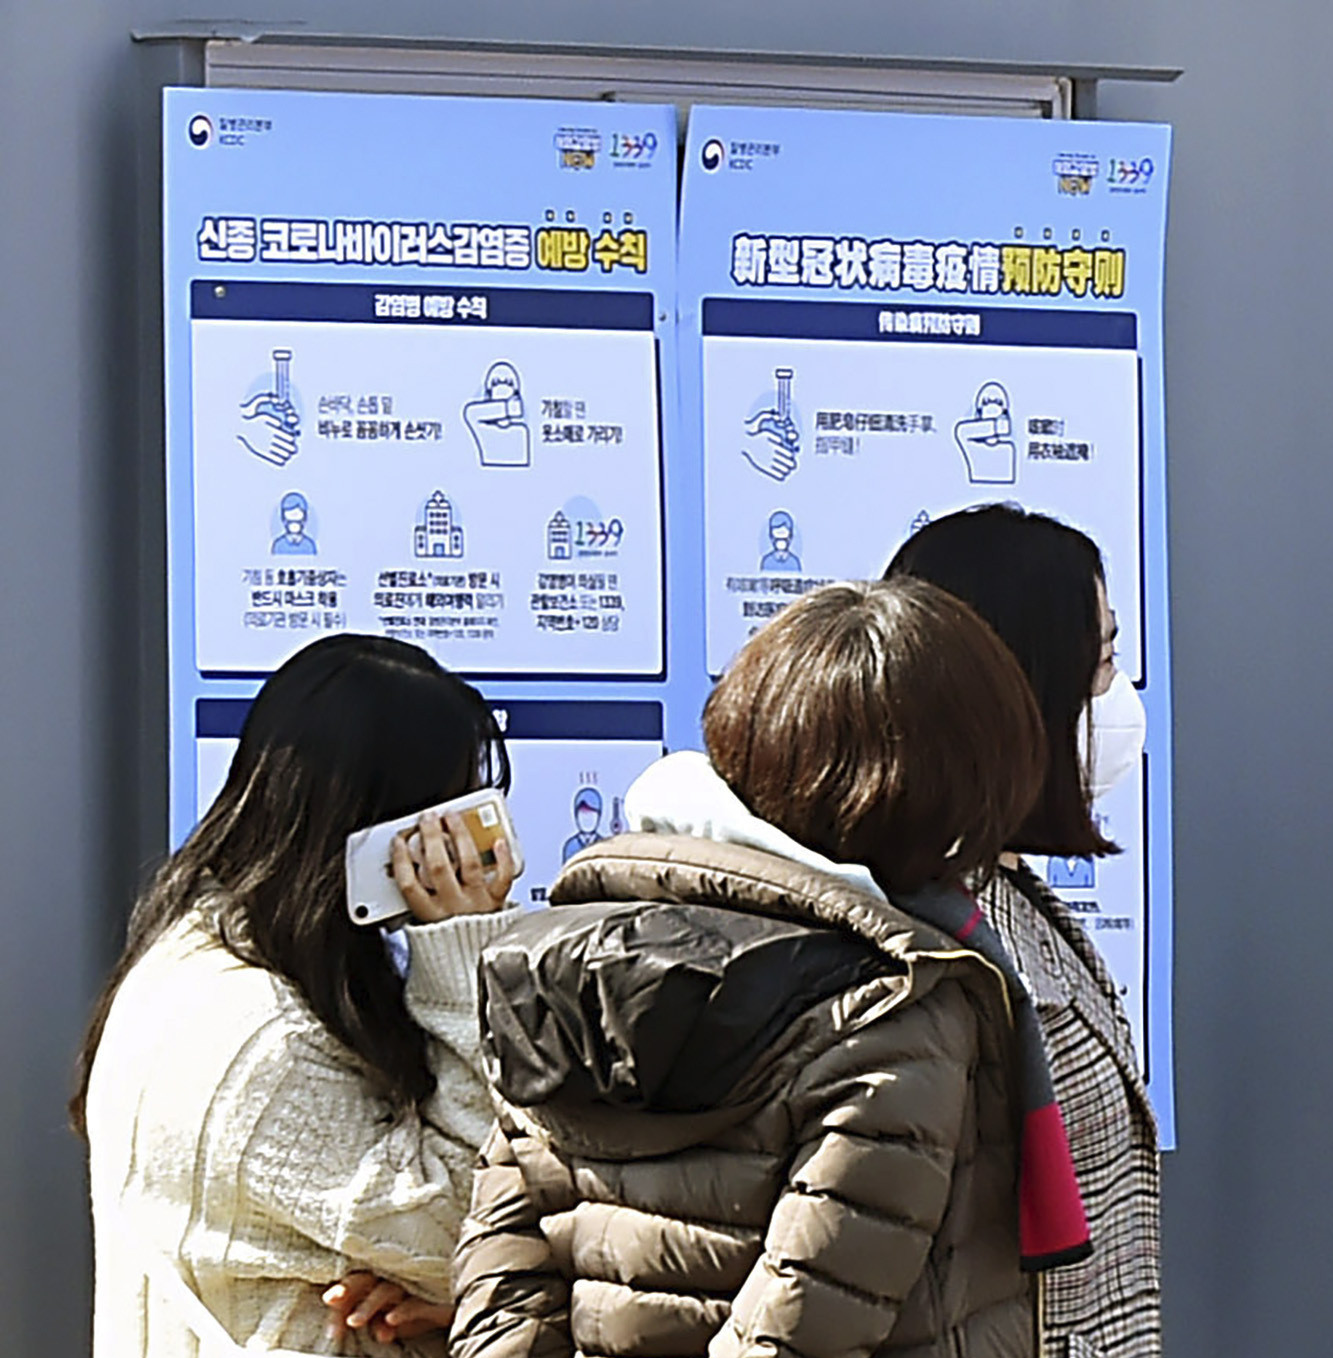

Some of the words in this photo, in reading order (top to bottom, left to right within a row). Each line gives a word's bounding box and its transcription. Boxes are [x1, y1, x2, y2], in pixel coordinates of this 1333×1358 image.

[609, 132, 658, 159] 1339
[1107, 157, 1154, 185] 1339
[198, 216, 255, 261] 신종
[260, 218, 531, 270] 코로나바이러스감염증
[535, 227, 591, 271] 예방
[593, 229, 647, 274] 수칙
[730, 233, 1126, 298] 新型冠状病毒疫情预防守则
[375, 295, 420, 317] 감염병
[457, 297, 487, 319] 수칙
[575, 519, 624, 547] 1339
